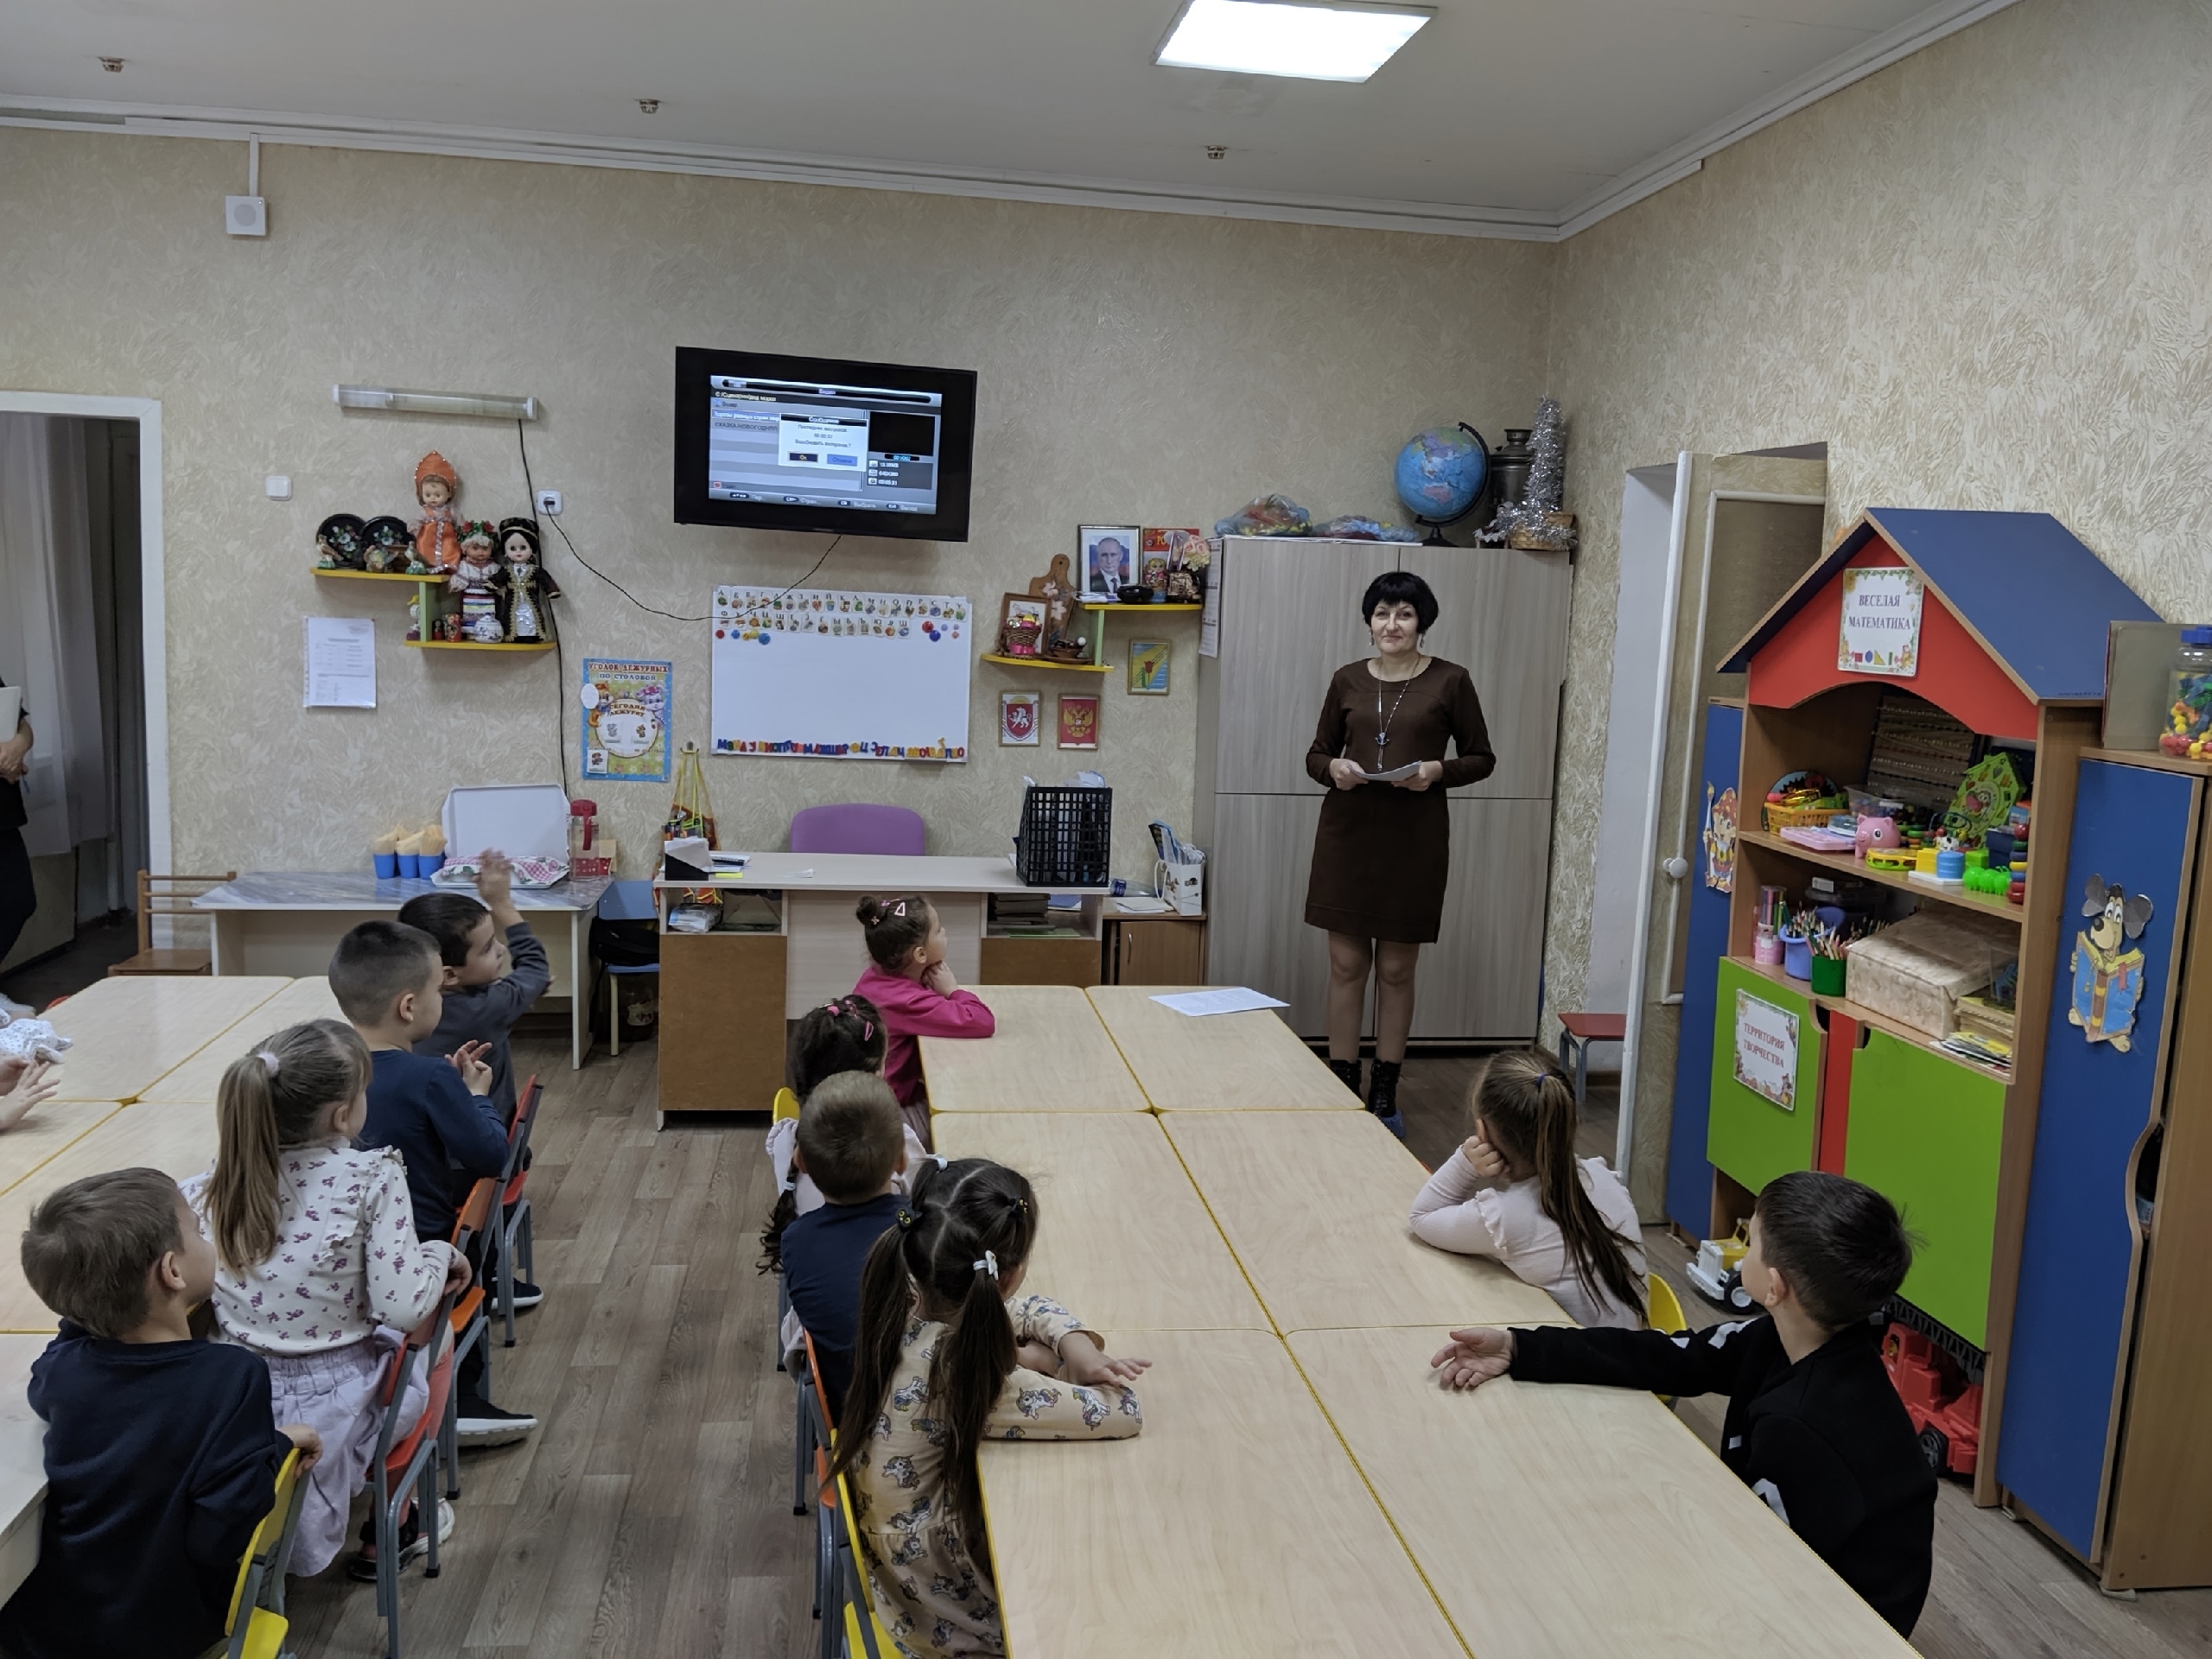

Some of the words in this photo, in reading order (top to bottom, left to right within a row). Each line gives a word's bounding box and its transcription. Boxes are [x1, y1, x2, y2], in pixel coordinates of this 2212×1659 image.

[1859, 594, 1900, 607] ВЕСЕЛАЯ
[1848, 616, 1910, 630] МАТЕМАТИКА
[1744, 1023, 1785, 1051] ТЕРРИТОРИЯ
[1744, 1039, 1784, 1068] ТВОРЧЕСТВА
